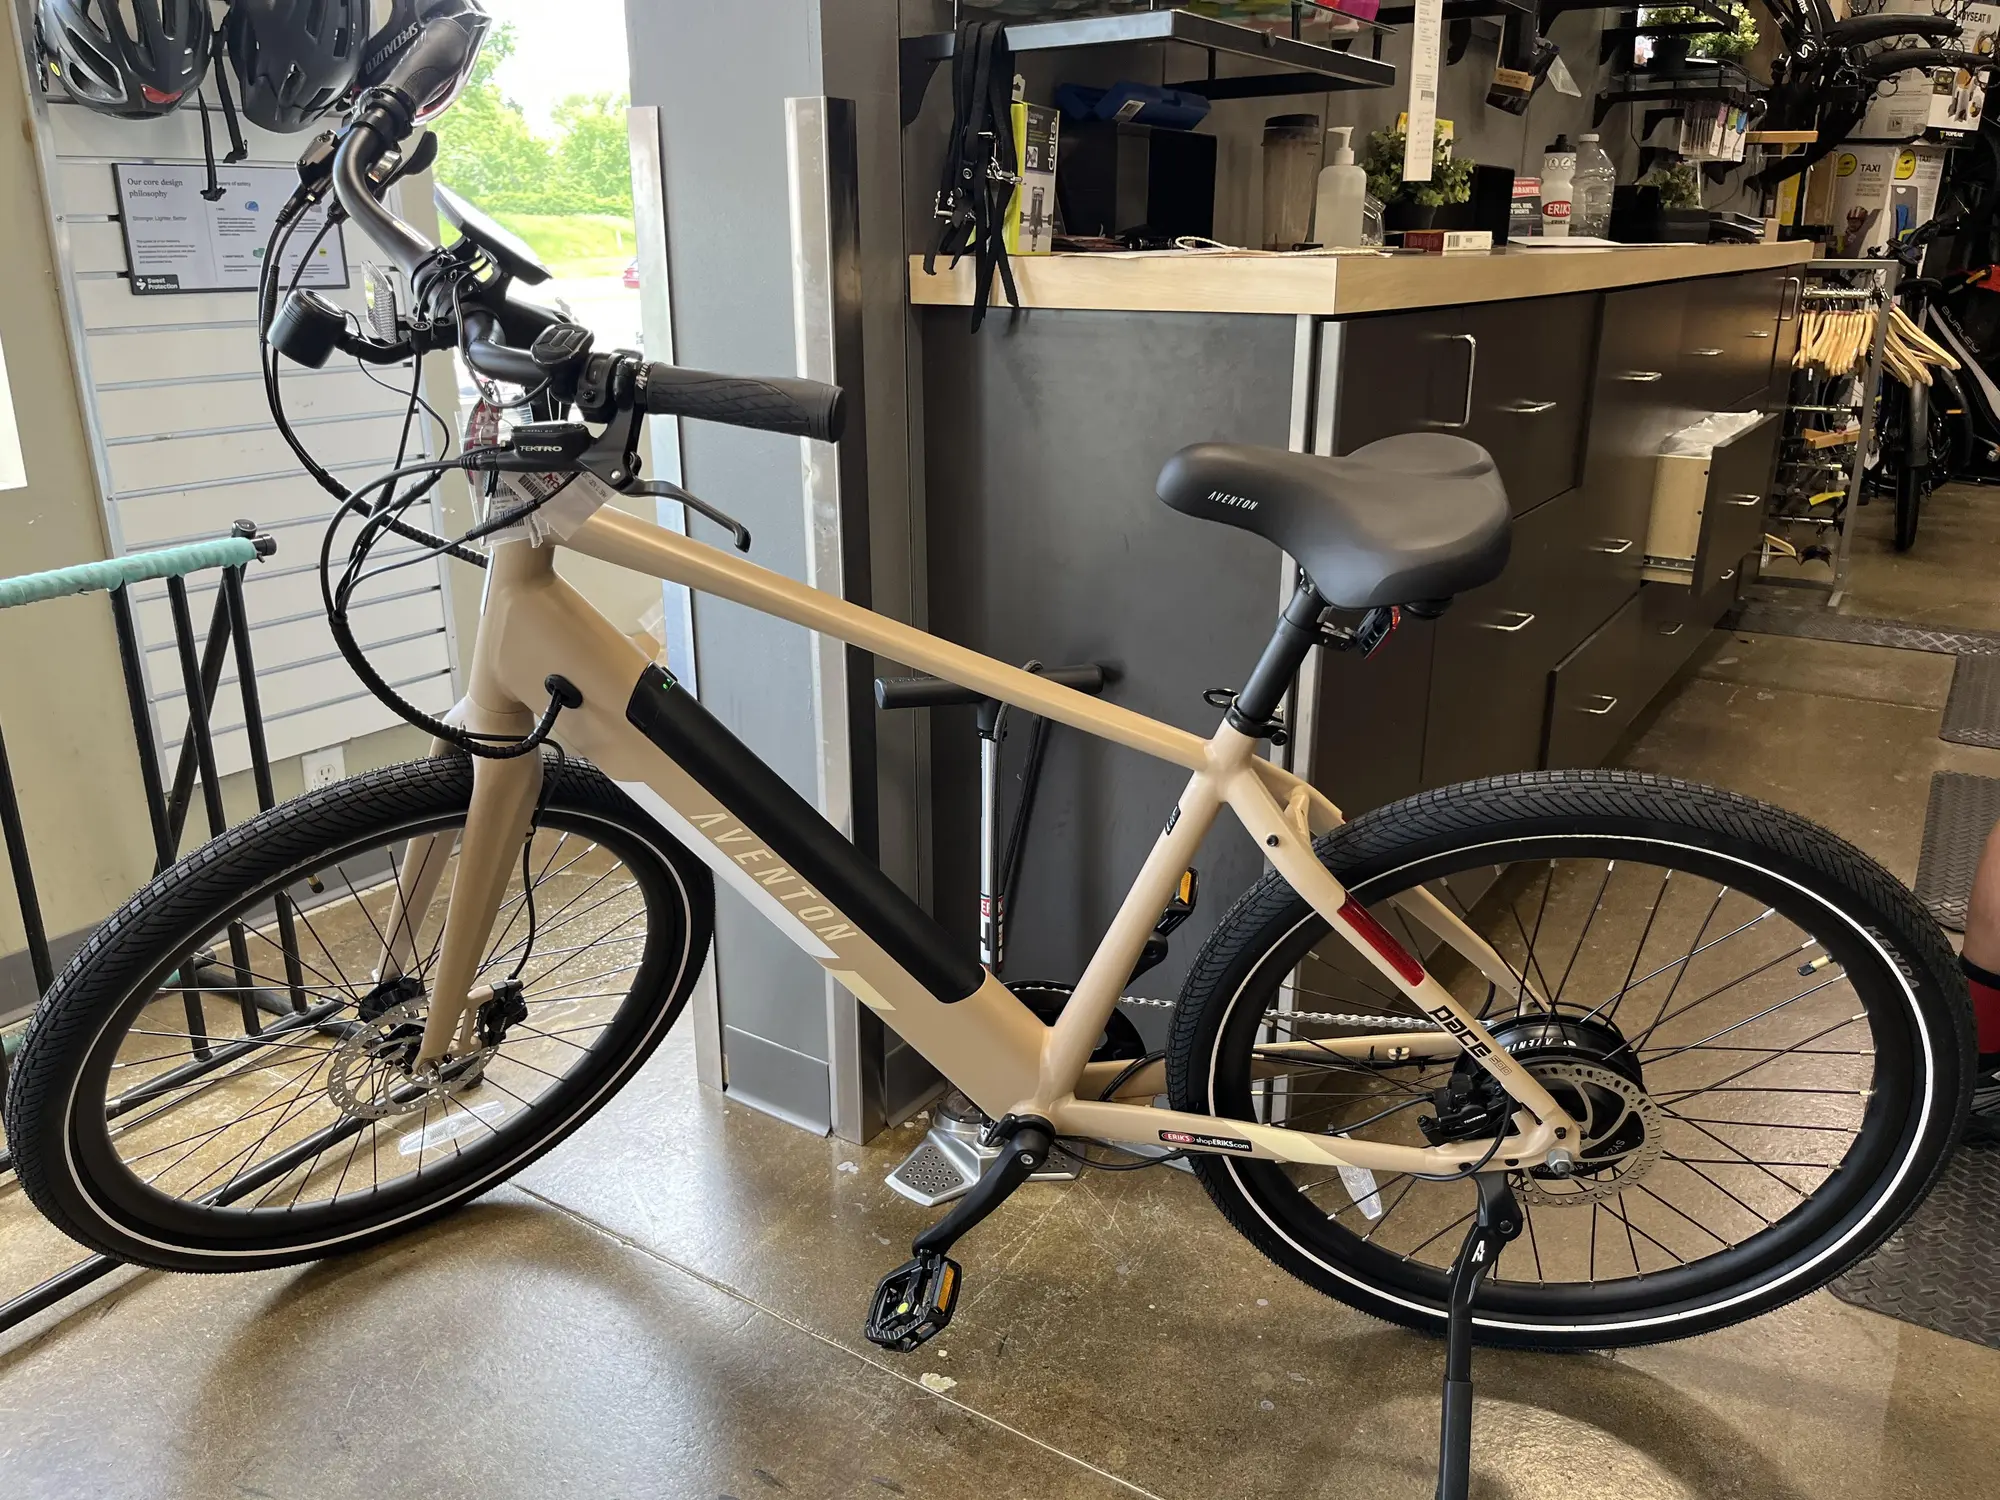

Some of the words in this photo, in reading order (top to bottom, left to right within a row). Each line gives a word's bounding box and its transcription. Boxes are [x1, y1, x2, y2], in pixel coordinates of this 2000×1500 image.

[1048, 121, 1056, 171] delta
[1860, 163, 1881, 173] TAXI
[127, 178, 141, 186] Our
[143, 178, 159, 186] core
[161, 177, 183, 187] design
[129, 190, 167, 199] philosophy
[1941, 306, 1980, 353] BURLEY
[1207, 490, 1259, 511] AVENTON
[690, 812, 858, 942] AVENTON
[1863, 925, 1920, 989] KENDA
[1488, 1054, 1513, 1076] 500
